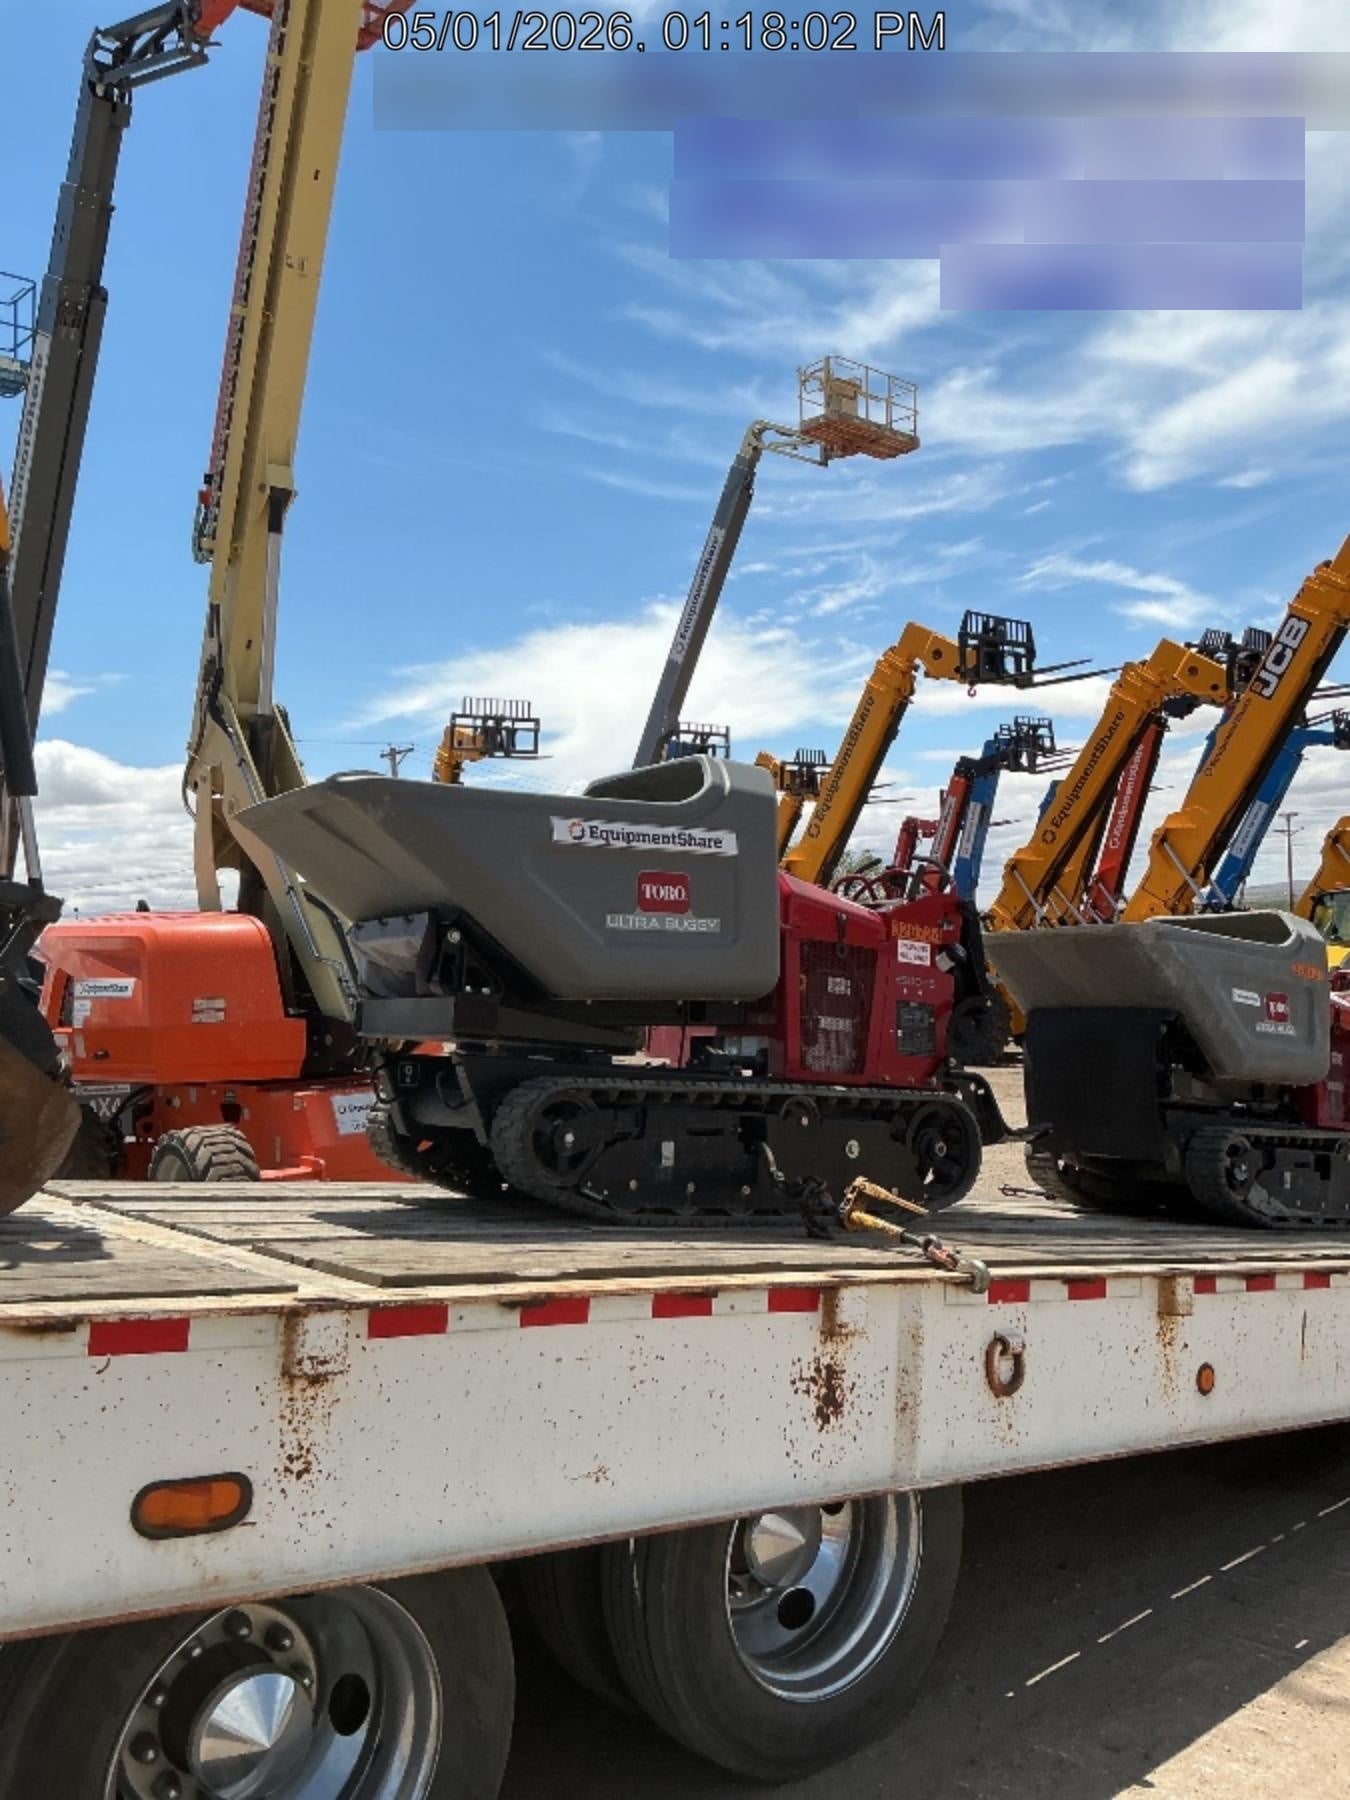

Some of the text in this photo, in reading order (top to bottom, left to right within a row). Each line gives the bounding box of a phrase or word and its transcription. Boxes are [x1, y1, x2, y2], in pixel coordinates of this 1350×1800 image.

[1259, 617, 1309, 697] JCB
[814, 696, 876, 826] EquipmentShare
[1051, 710, 1125, 829] EquipmentShare
[588, 825, 724, 849] EquipmentShare
[641, 884, 687, 901] TORO
[606, 915, 660, 929] ULTRA
